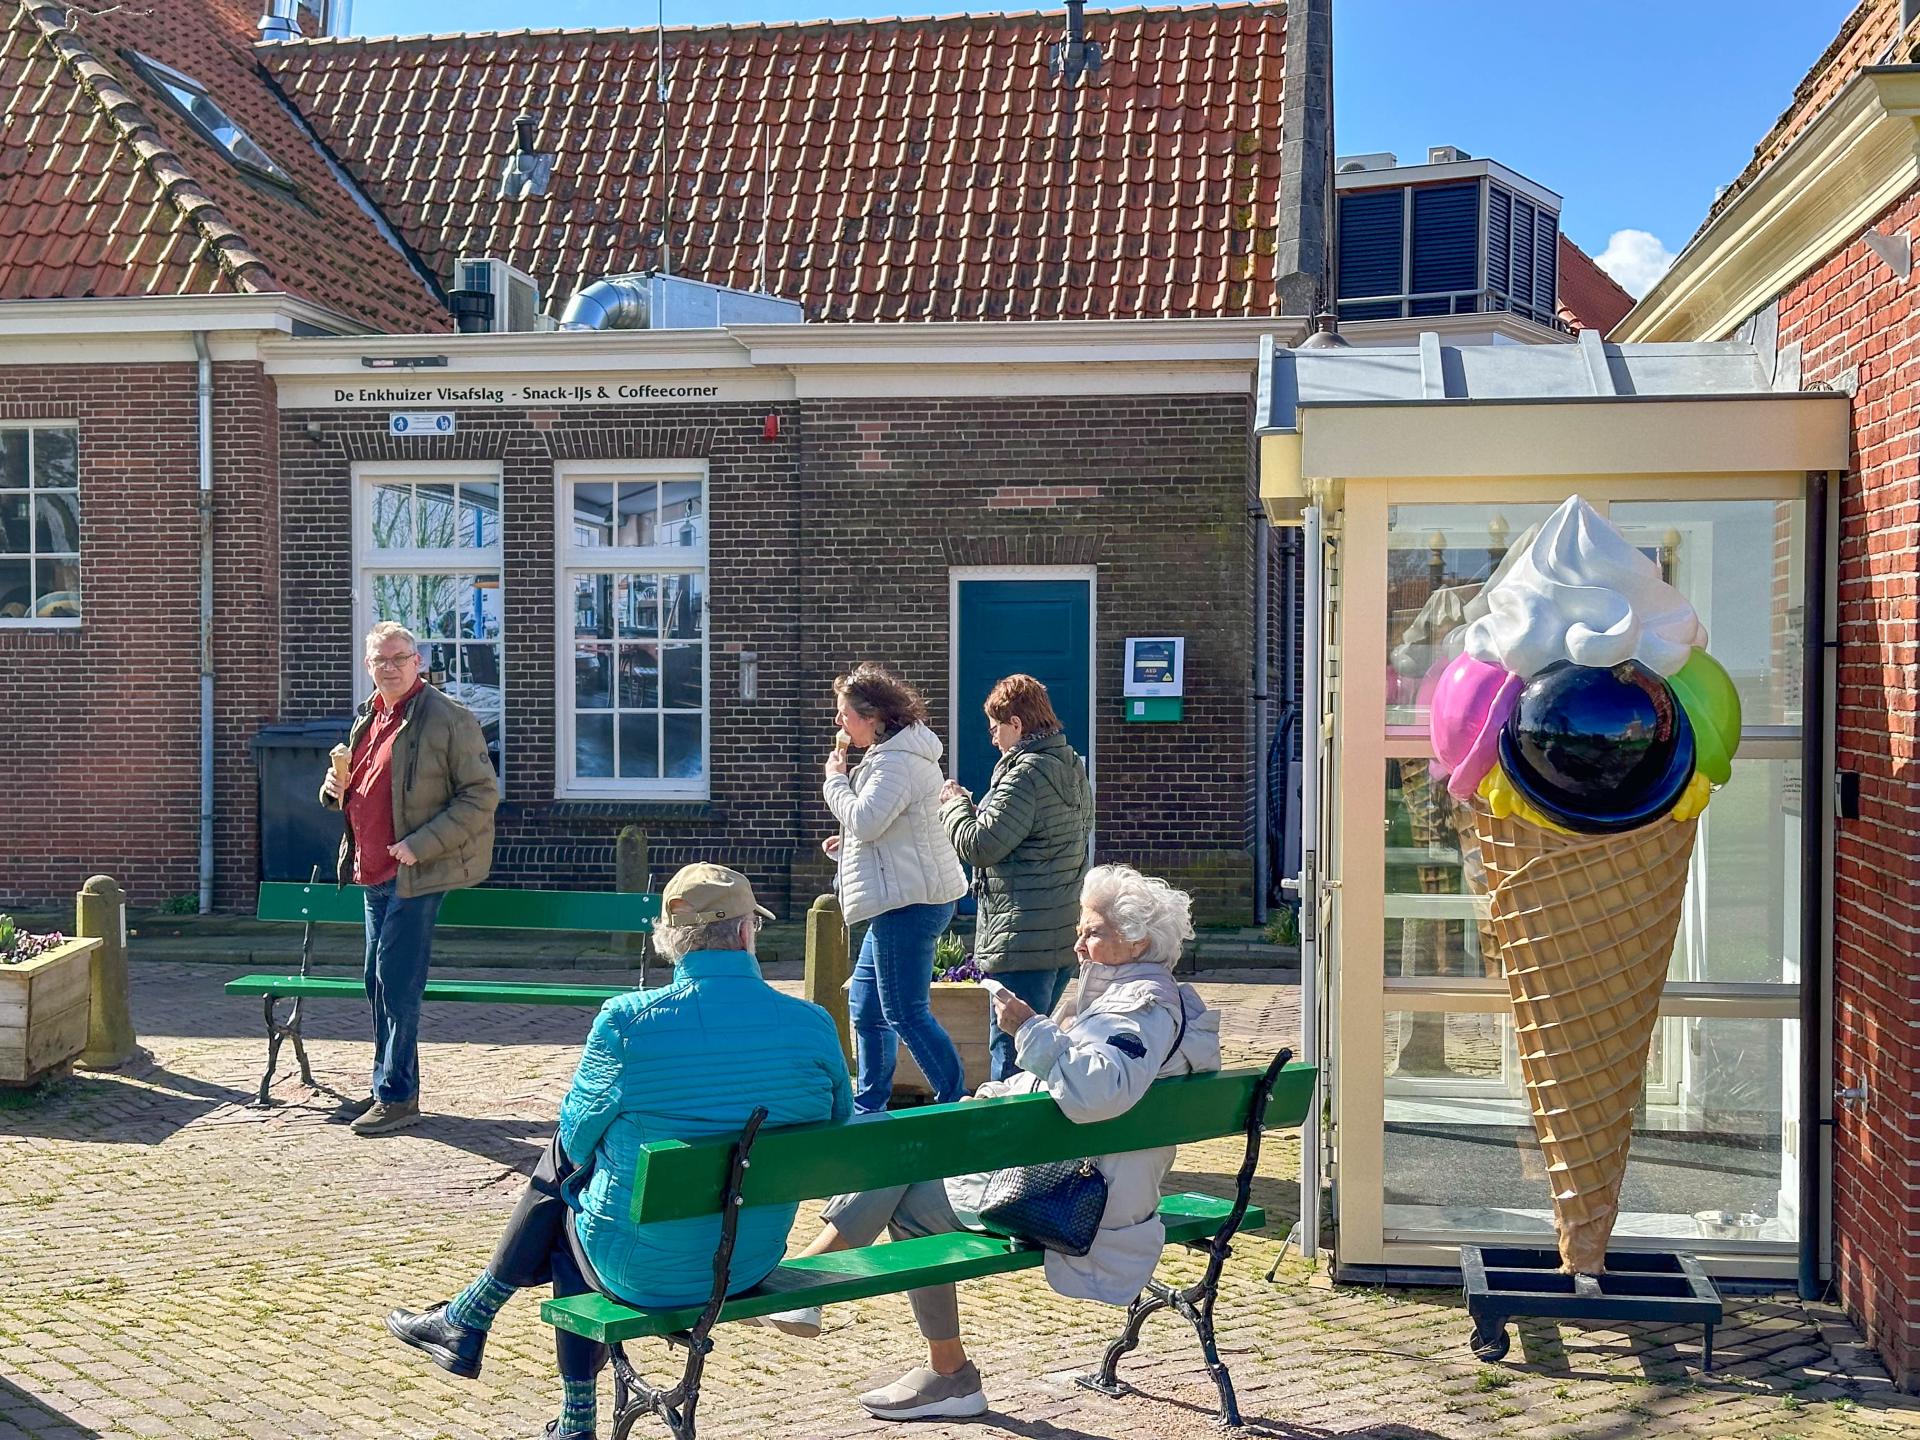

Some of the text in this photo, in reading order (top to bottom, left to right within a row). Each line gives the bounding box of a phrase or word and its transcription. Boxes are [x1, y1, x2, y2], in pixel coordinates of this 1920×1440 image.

[334, 389, 354, 402] De
[359, 388, 433, 402] Enkhuizer
[437, 387, 504, 403] Visafslag
[522, 386, 592, 401] Snack-IJs
[597, 386, 611, 399] &
[618, 384, 719, 398] Coffeecorner
